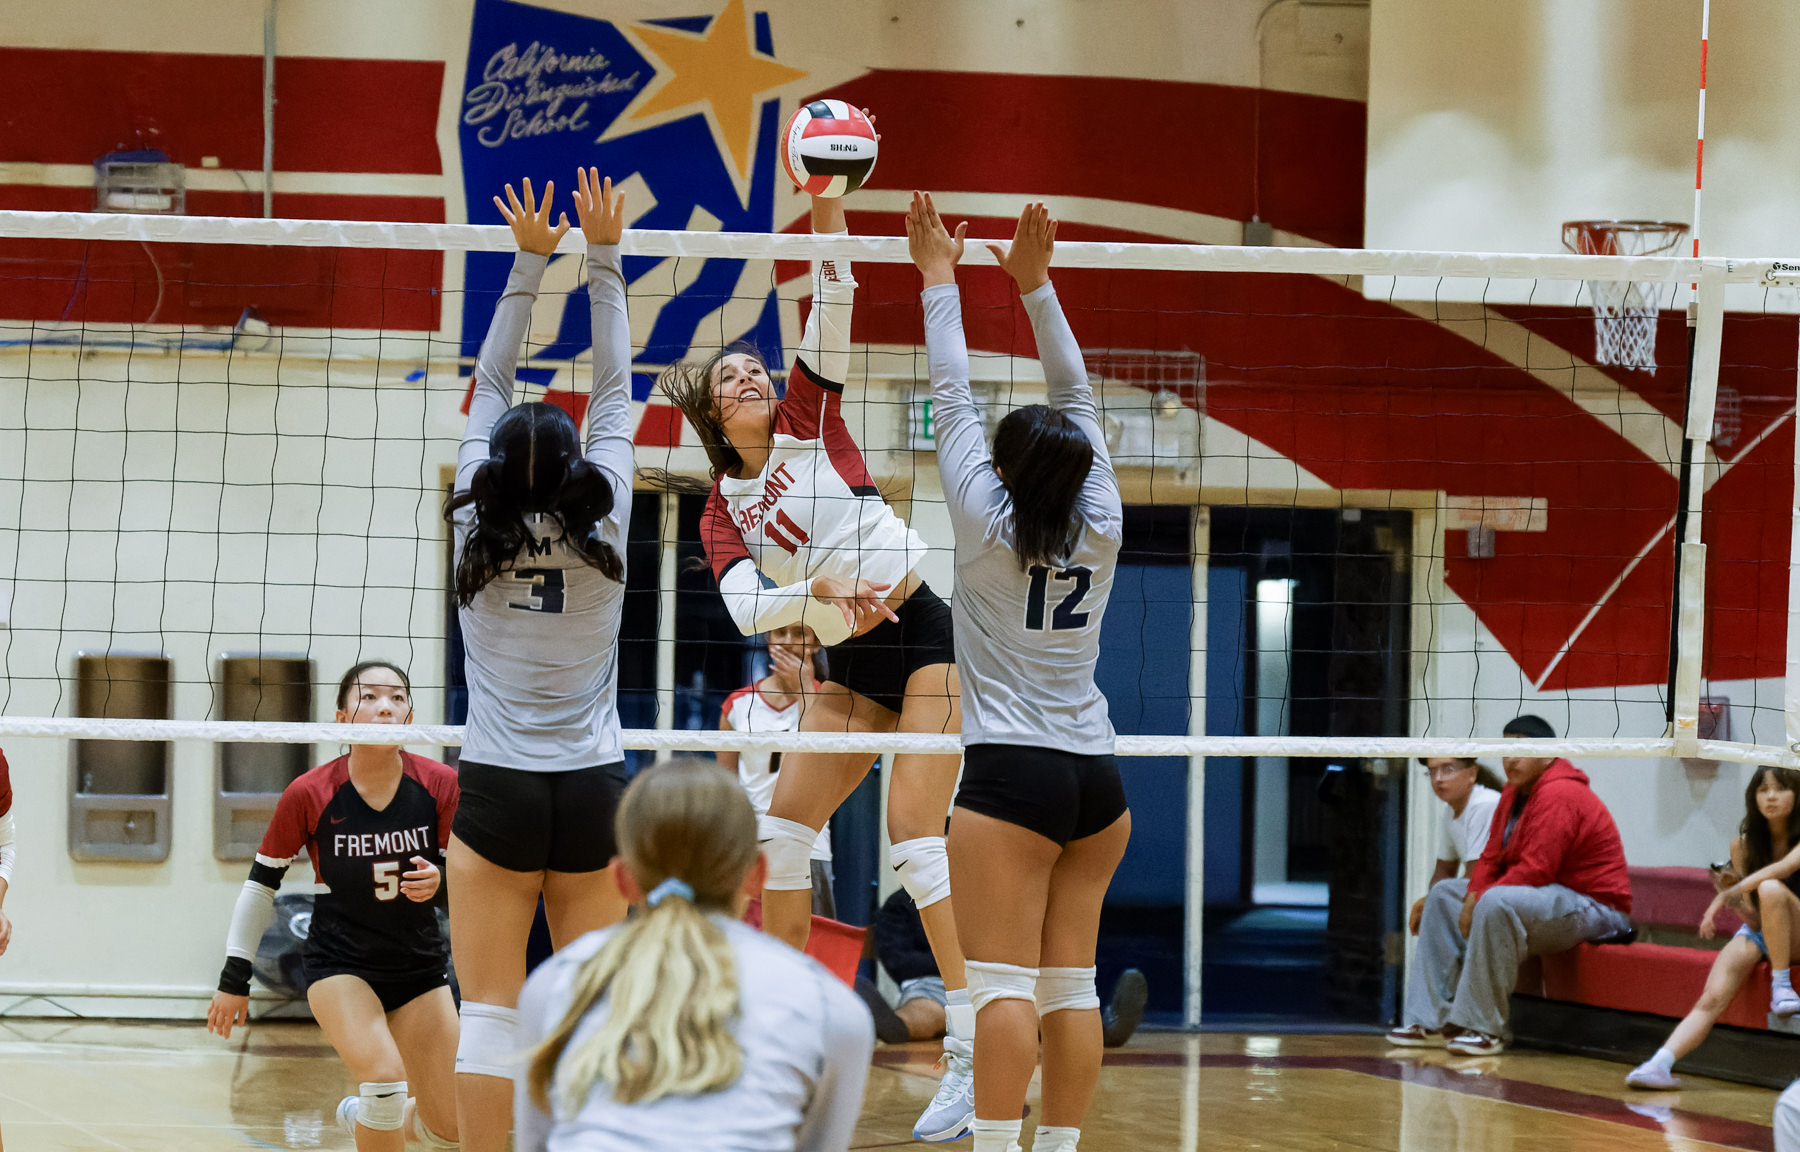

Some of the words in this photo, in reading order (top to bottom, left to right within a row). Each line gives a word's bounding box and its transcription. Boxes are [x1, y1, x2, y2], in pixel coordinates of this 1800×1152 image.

[483, 41, 610, 87] California
[464, 71, 640, 124] Distinguished
[477, 101, 590, 148] School
[765, 507, 810, 557] 11
[506, 568, 567, 614] 3
[1024, 564, 1093, 632] 12
[334, 826, 429, 857] FREMONT
[372, 861, 400, 901] 5
